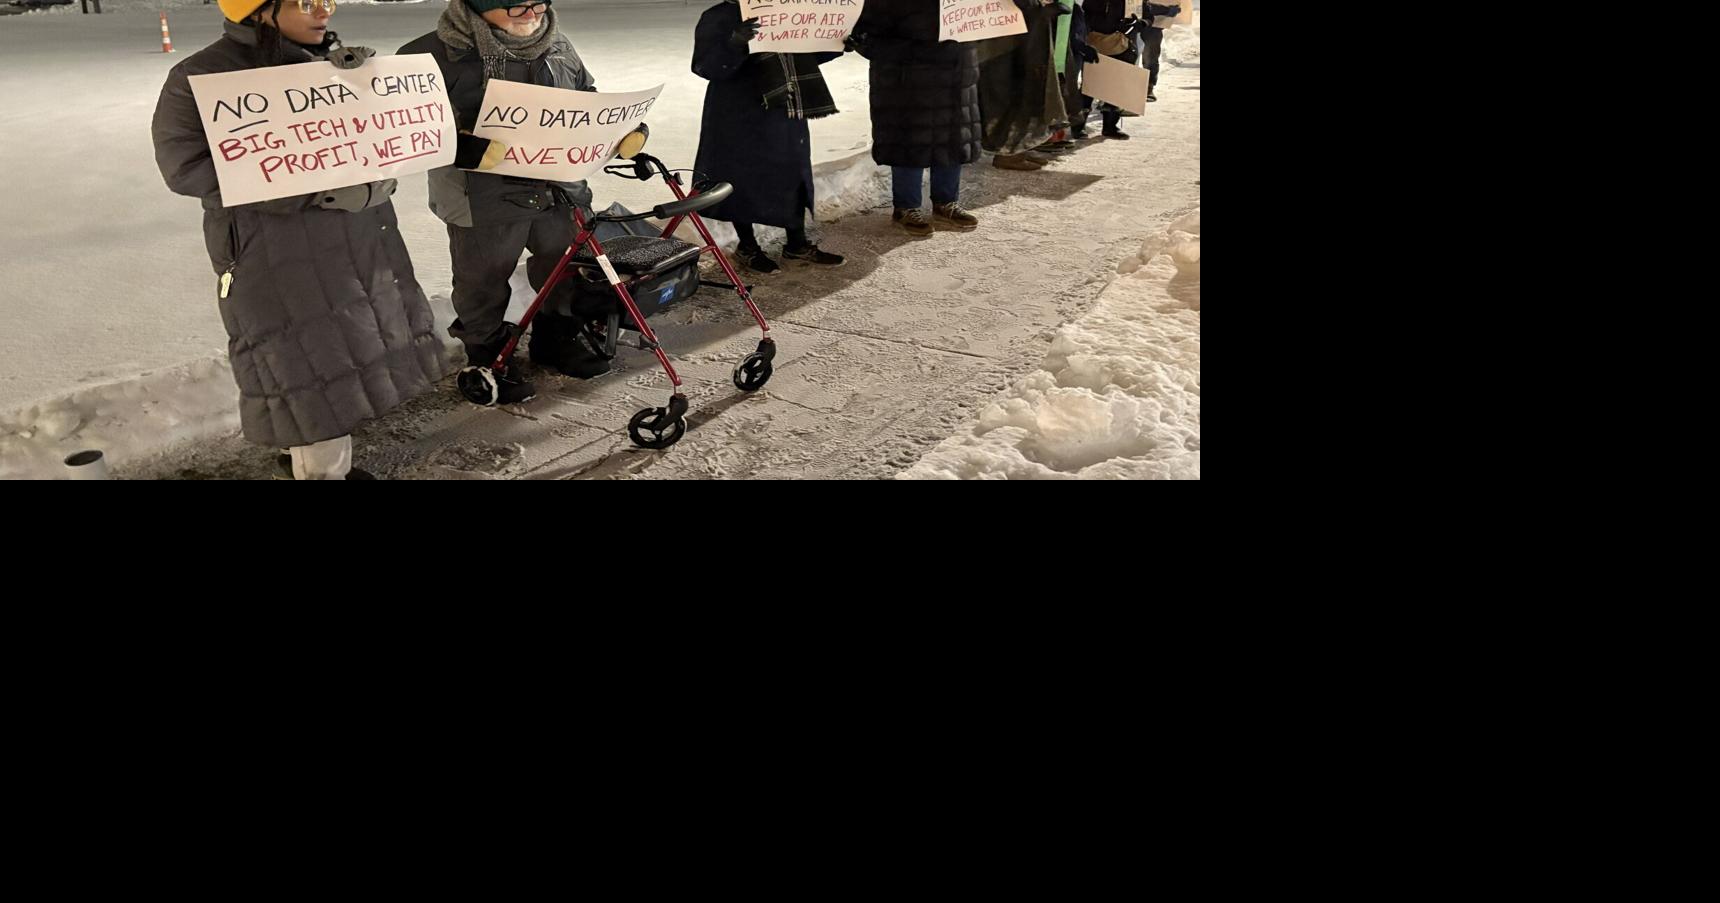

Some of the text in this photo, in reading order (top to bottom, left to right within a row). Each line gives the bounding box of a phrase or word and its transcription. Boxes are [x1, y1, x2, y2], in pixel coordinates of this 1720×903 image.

[760, 12, 845, 27] EEP OUR AIR
[942, 2, 1003, 26] KEEP OUR AIR
[957, 20, 986, 34] WATER
[989, 13, 1018, 27] CLEAN
[770, 28, 809, 41] WATER
[814, 28, 848, 39] CLEAN
[213, 73, 441, 122] NO DATA CENTER
[484, 97, 656, 128] NO DATA CENTER
[218, 101, 444, 162] BIG TECH & UTILITY
[259, 129, 442, 183] PROFIT, WE PAY
[504, 146, 564, 165] AVE
[567, 143, 604, 165] OUR
